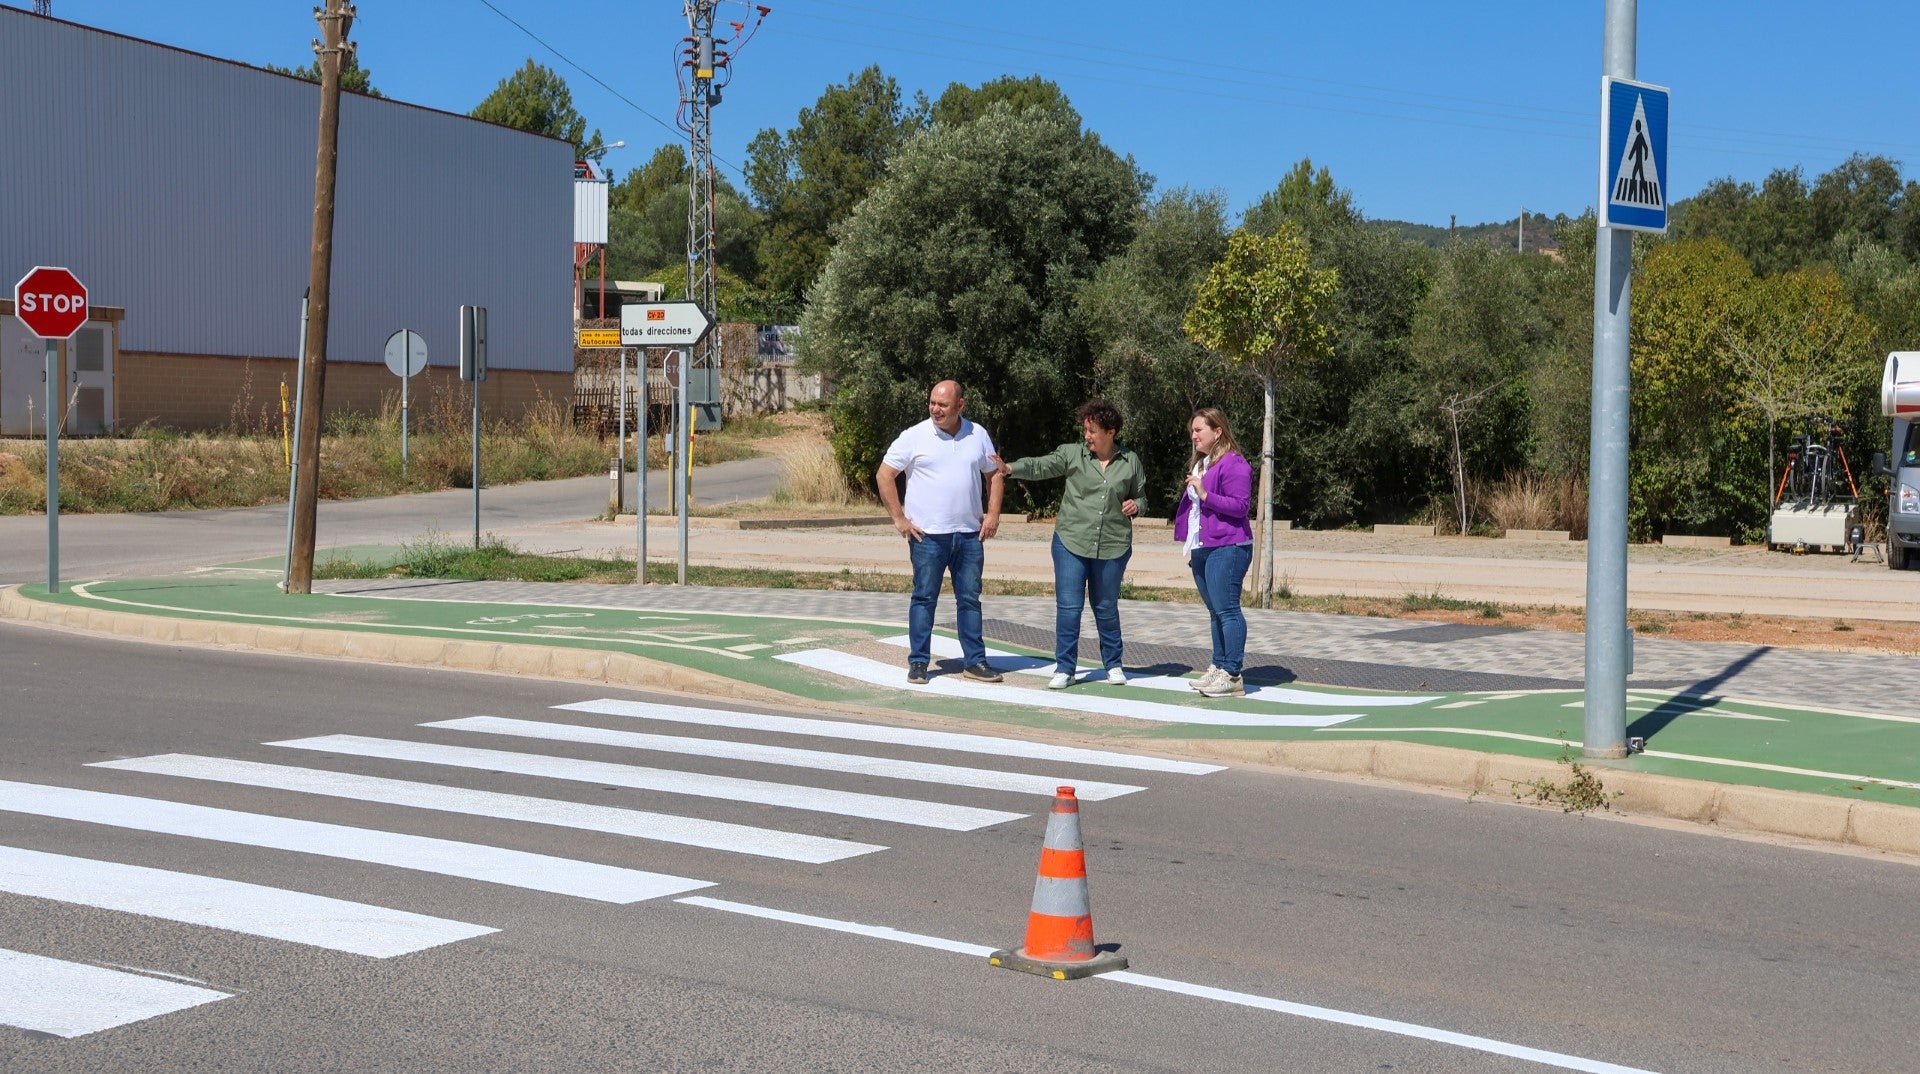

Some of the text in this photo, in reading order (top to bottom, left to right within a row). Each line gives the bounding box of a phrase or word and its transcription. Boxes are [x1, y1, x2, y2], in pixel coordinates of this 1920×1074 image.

[21, 292, 85, 313] STOP
[647, 311, 665, 319] CV-20
[622, 326, 692, 336] todas direcciones
